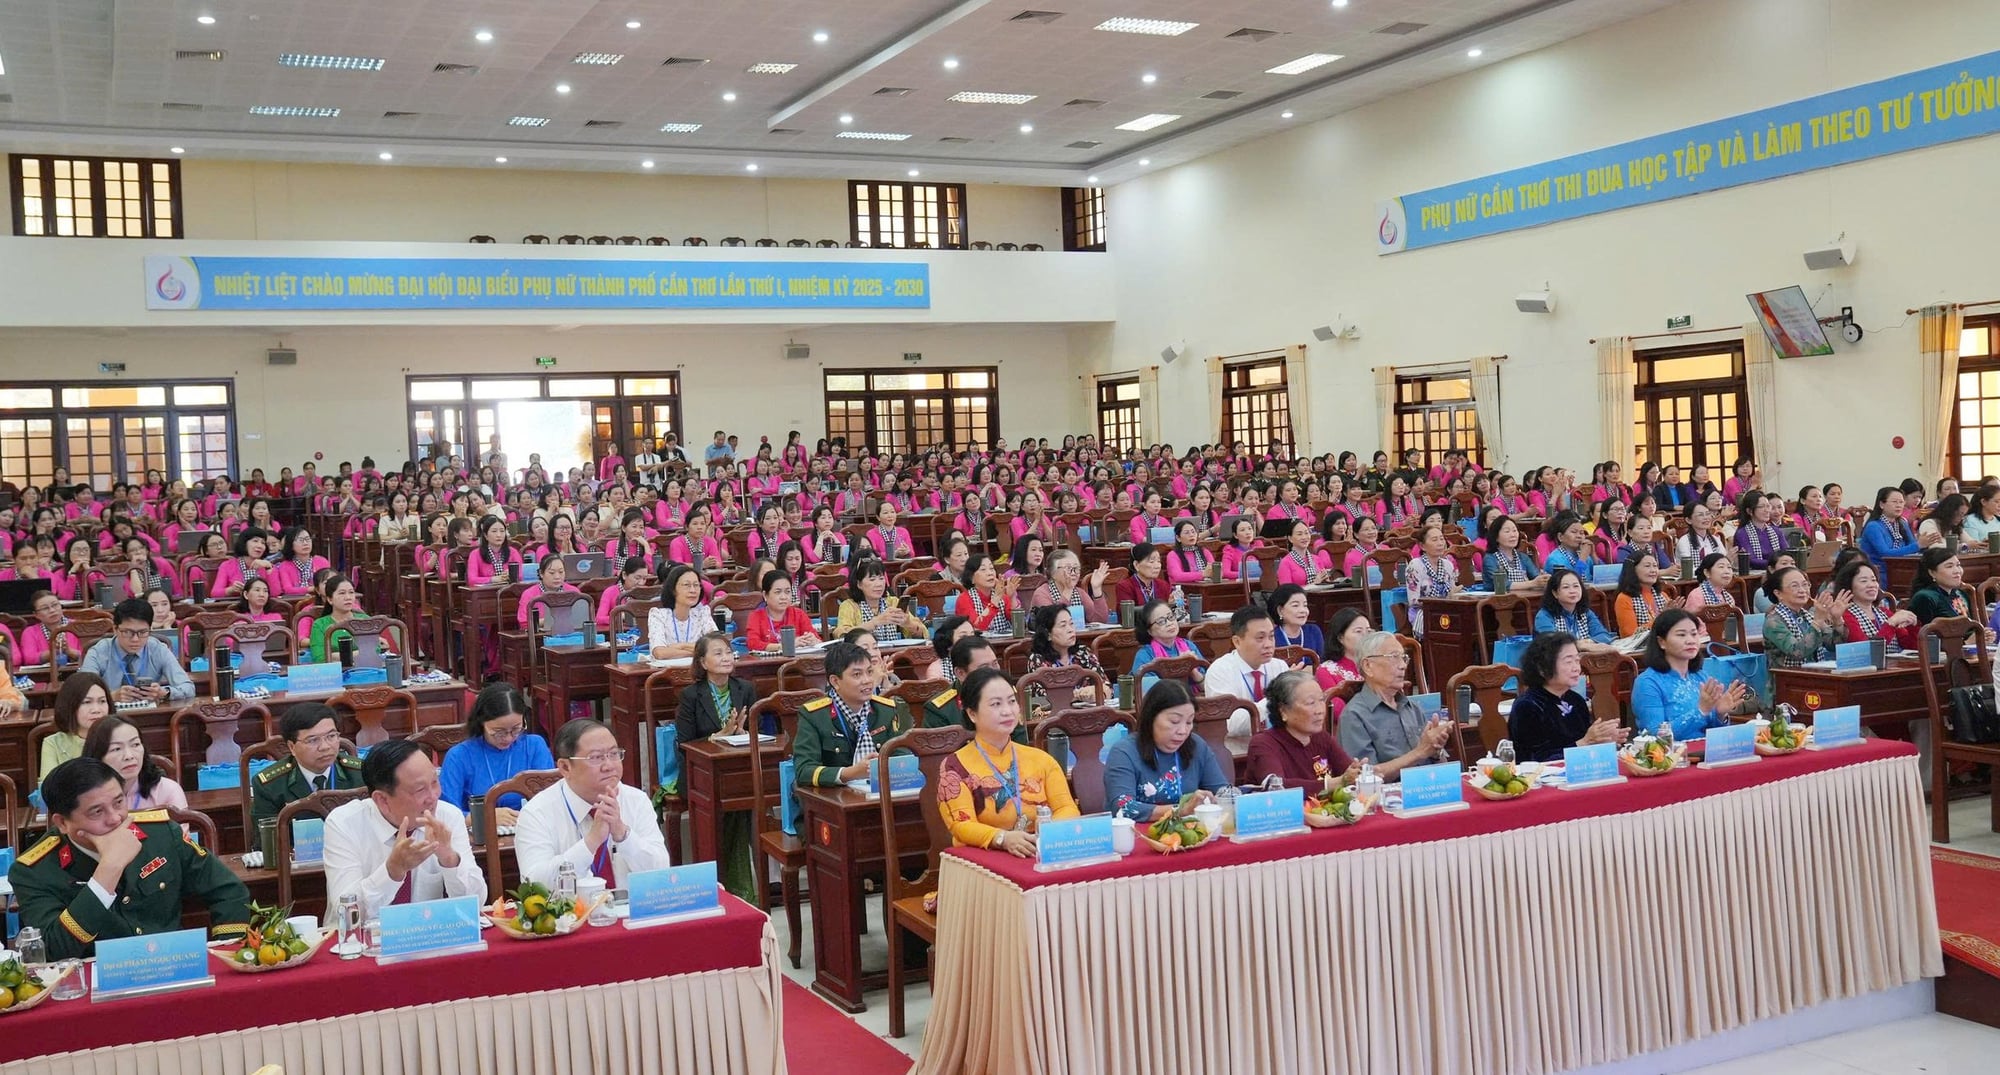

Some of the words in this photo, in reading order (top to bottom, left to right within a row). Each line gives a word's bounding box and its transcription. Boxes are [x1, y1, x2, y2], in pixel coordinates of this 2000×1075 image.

[1420, 202, 1449, 232] PHỤ
[1455, 191, 1478, 224] NỮ
[1480, 182, 1515, 218] CẦN
[1518, 177, 1551, 211] THƠ
[1553, 173, 1583, 203] THI
[1587, 165, 1624, 197] ĐUA
[1629, 154, 1668, 190] HỌC
[1673, 141, 1713, 182] TẬP
[1718, 129, 1748, 169] VÀ
[1753, 122, 1802, 161] LÀM
[1809, 106, 1872, 149] THEO
[1878, 91, 1915, 133] TƯ
[1919, 71, 2000, 124] TƯỞN
[214, 271, 261, 300] NHIỆT
[265, 271, 298, 300] LIỆT
[302, 272, 344, 296] CHÀO
[348, 272, 395, 296] MỪNG
[398, 276, 424, 300] ĐẠI
[428, 272, 453, 300] HỘI
[457, 276, 482, 300] ĐẠI
[486, 269, 520, 296] BIỂU
[523, 276, 551, 300] PHỤ
[556, 273, 577, 296] NỮ
[579, 273, 625, 297] THÀNH
[628, 271, 657, 296] PHỐ
[660, 271, 688, 296] CẦN
[691, 275, 717, 296] THƠ
[719, 271, 746, 296] LẦN
[749, 274, 775, 296] THỨ
[788, 274, 831, 300] NHIỆM
[853, 277, 884, 297] 2025
[894, 278, 924, 297] 2030
